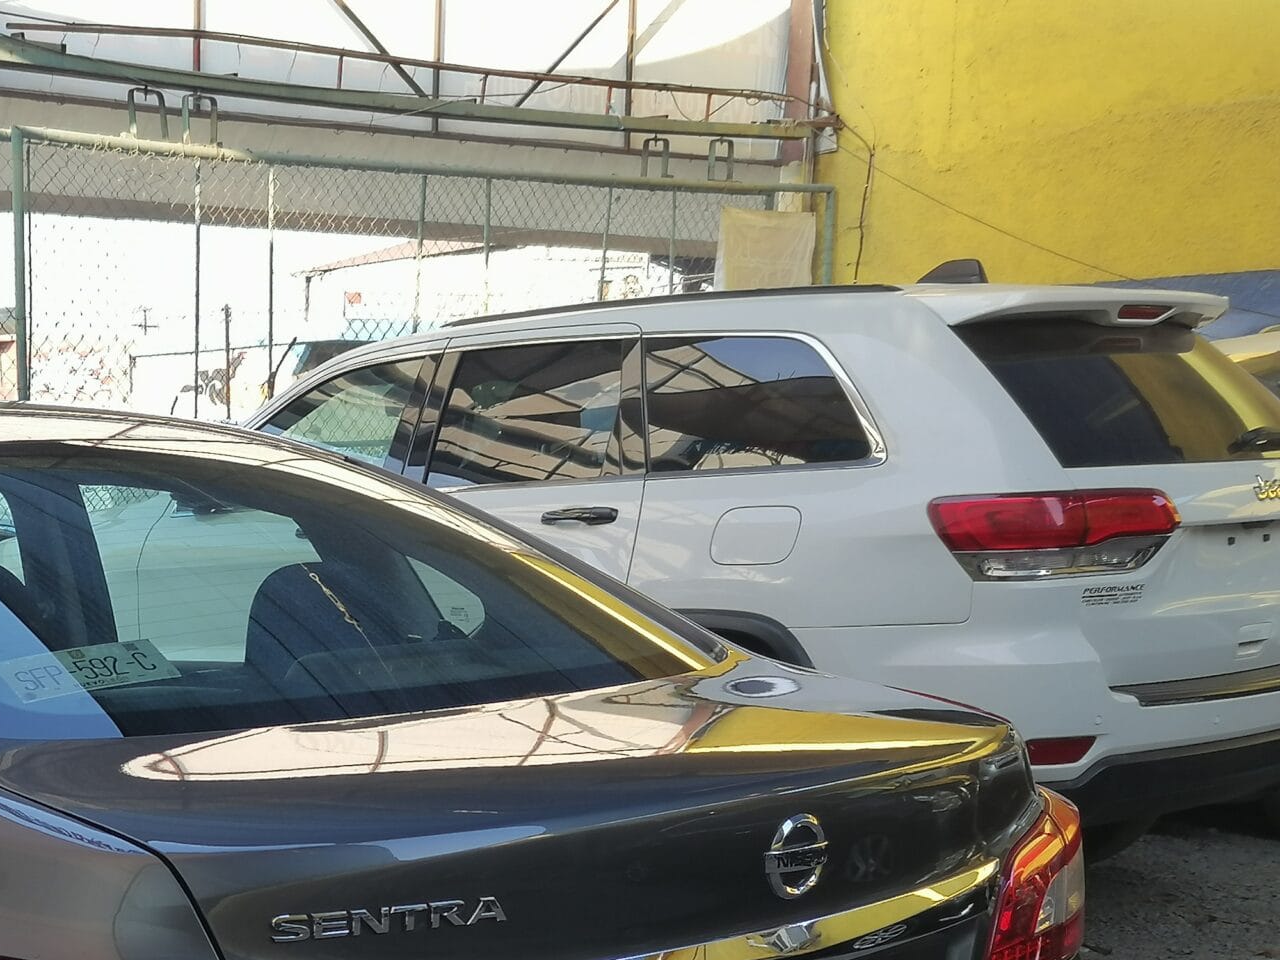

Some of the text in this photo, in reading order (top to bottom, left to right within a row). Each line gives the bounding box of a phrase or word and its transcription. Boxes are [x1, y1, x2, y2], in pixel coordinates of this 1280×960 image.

[1082, 584, 1146, 594] PERFORMANCE
[14, 651, 157, 691] SFP-592-C
[271, 896, 507, 942] SENTRA
